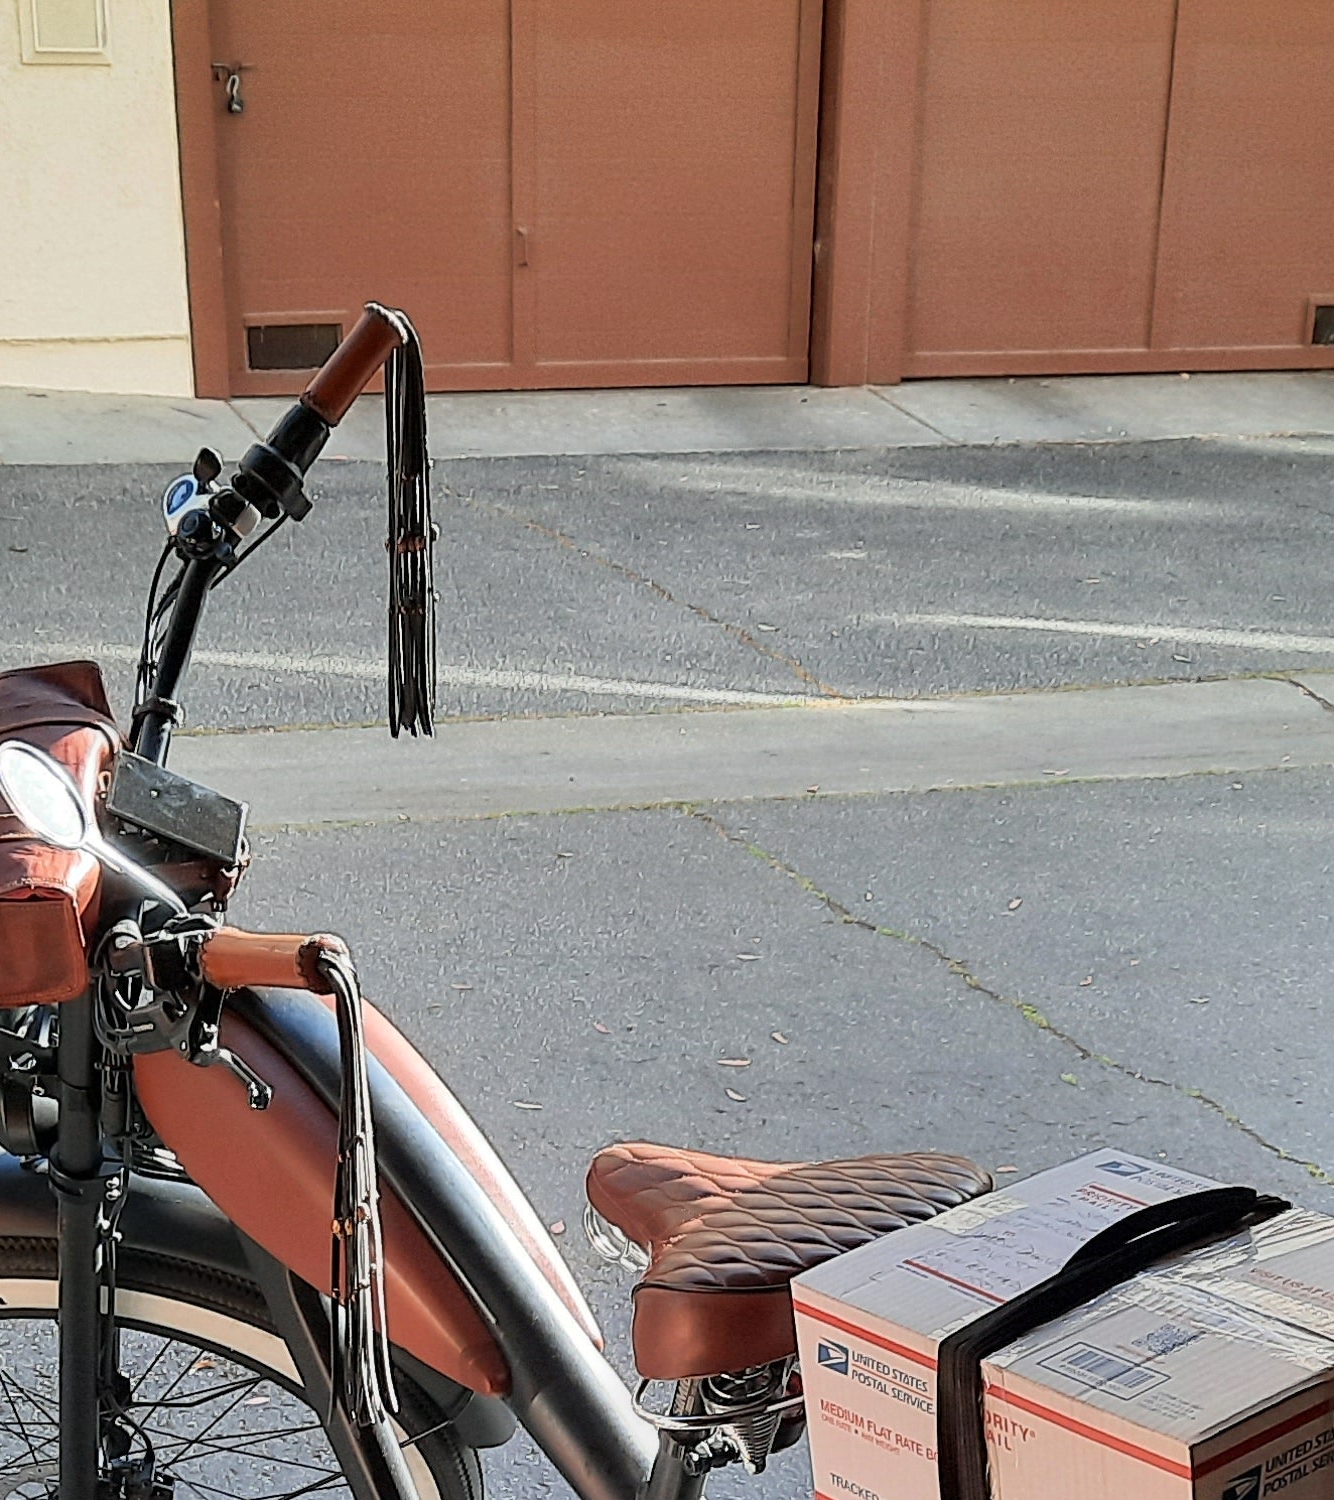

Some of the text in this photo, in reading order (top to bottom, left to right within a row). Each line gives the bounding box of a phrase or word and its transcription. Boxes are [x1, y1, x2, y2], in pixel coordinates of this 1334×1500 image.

[851, 1350, 929, 1393] UNITED STATES
[851, 1369, 890, 1396] POSTAL
[820, 1399, 865, 1429] MEDIUM
[867, 1420, 893, 1441] FLAT
[895, 1433, 924, 1457] RATE
[986, 1429, 1013, 1451] AIL
[1265, 1440, 1314, 1474] UNITED
[1262, 1464, 1310, 1497] POSTAL
